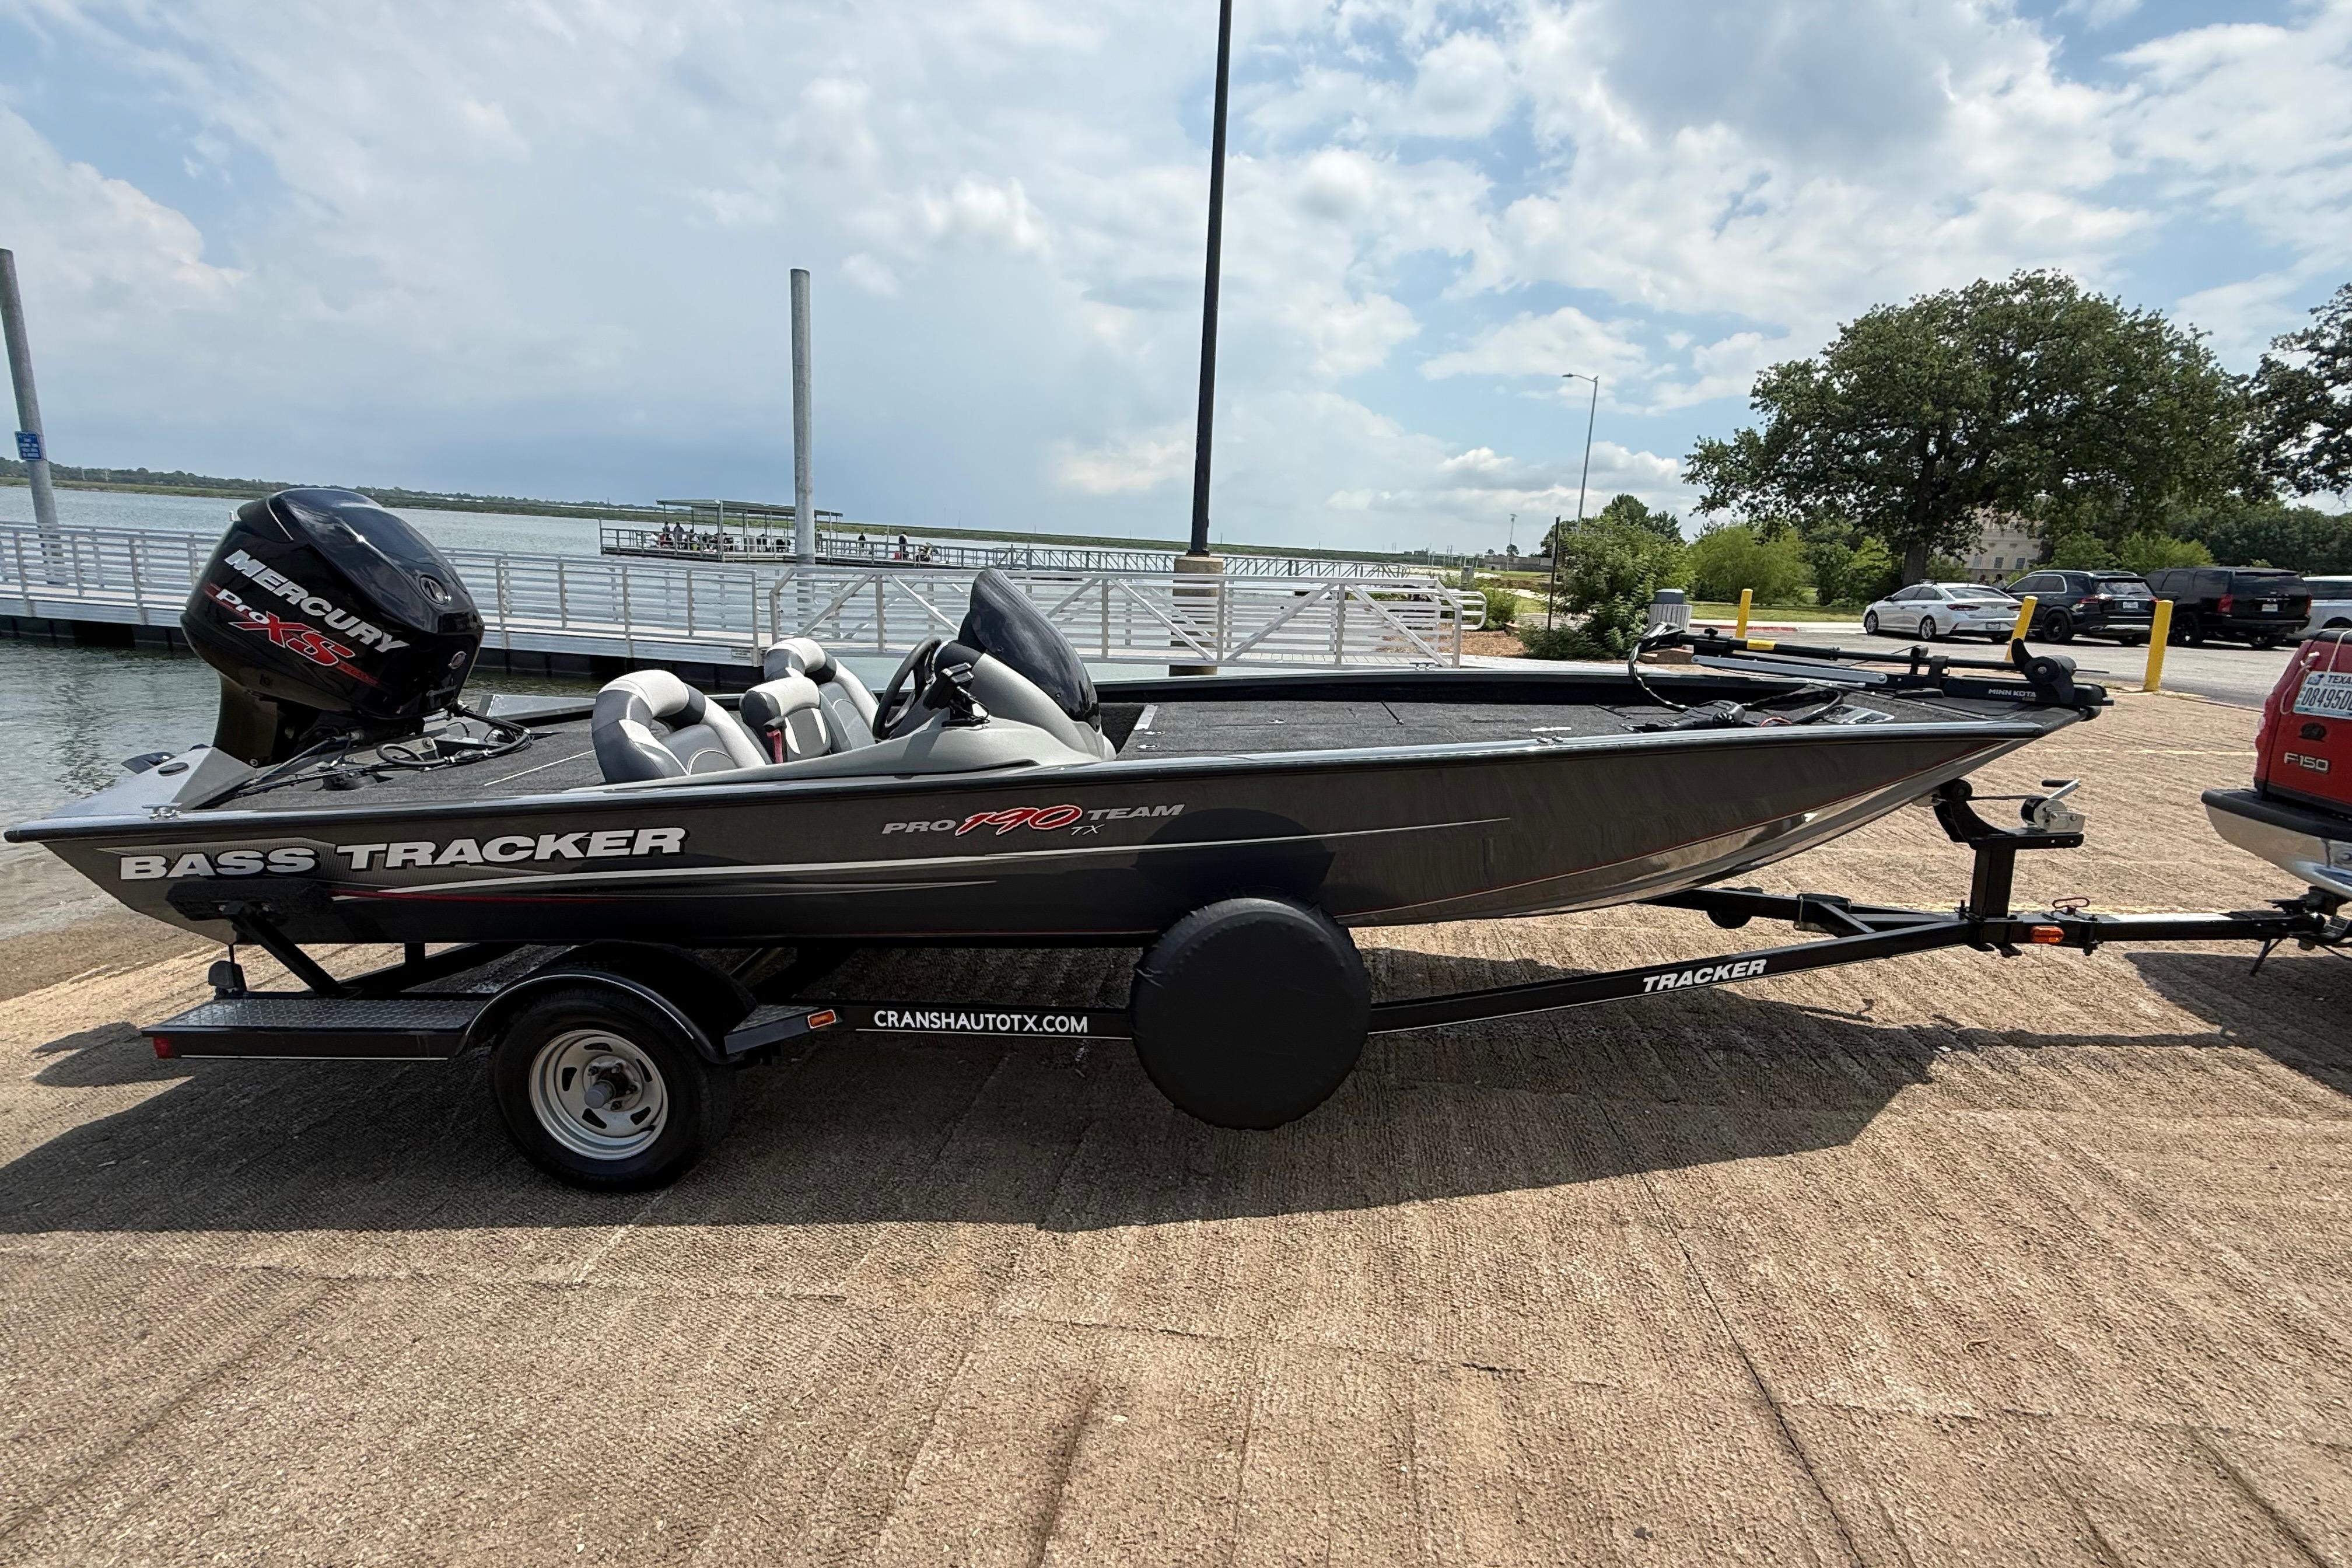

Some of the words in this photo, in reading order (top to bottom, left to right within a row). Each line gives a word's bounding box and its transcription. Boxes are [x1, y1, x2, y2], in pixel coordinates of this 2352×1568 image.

[224, 549, 410, 653] MERCURY
[228, 611, 356, 666] XS
[2328, 675, 2352, 685] TEXA
[882, 820, 957, 834] PRO
[955, 804, 1084, 836] 190
[1087, 804, 1185, 821] TEAM
[1071, 824, 1105, 836] TX
[120, 848, 317, 880] BASS
[337, 827, 685, 869] TRACKER
[1643, 959, 1768, 993] TRACKER
[874, 1010, 1088, 1033] CRANSHAUTOTX.COM
